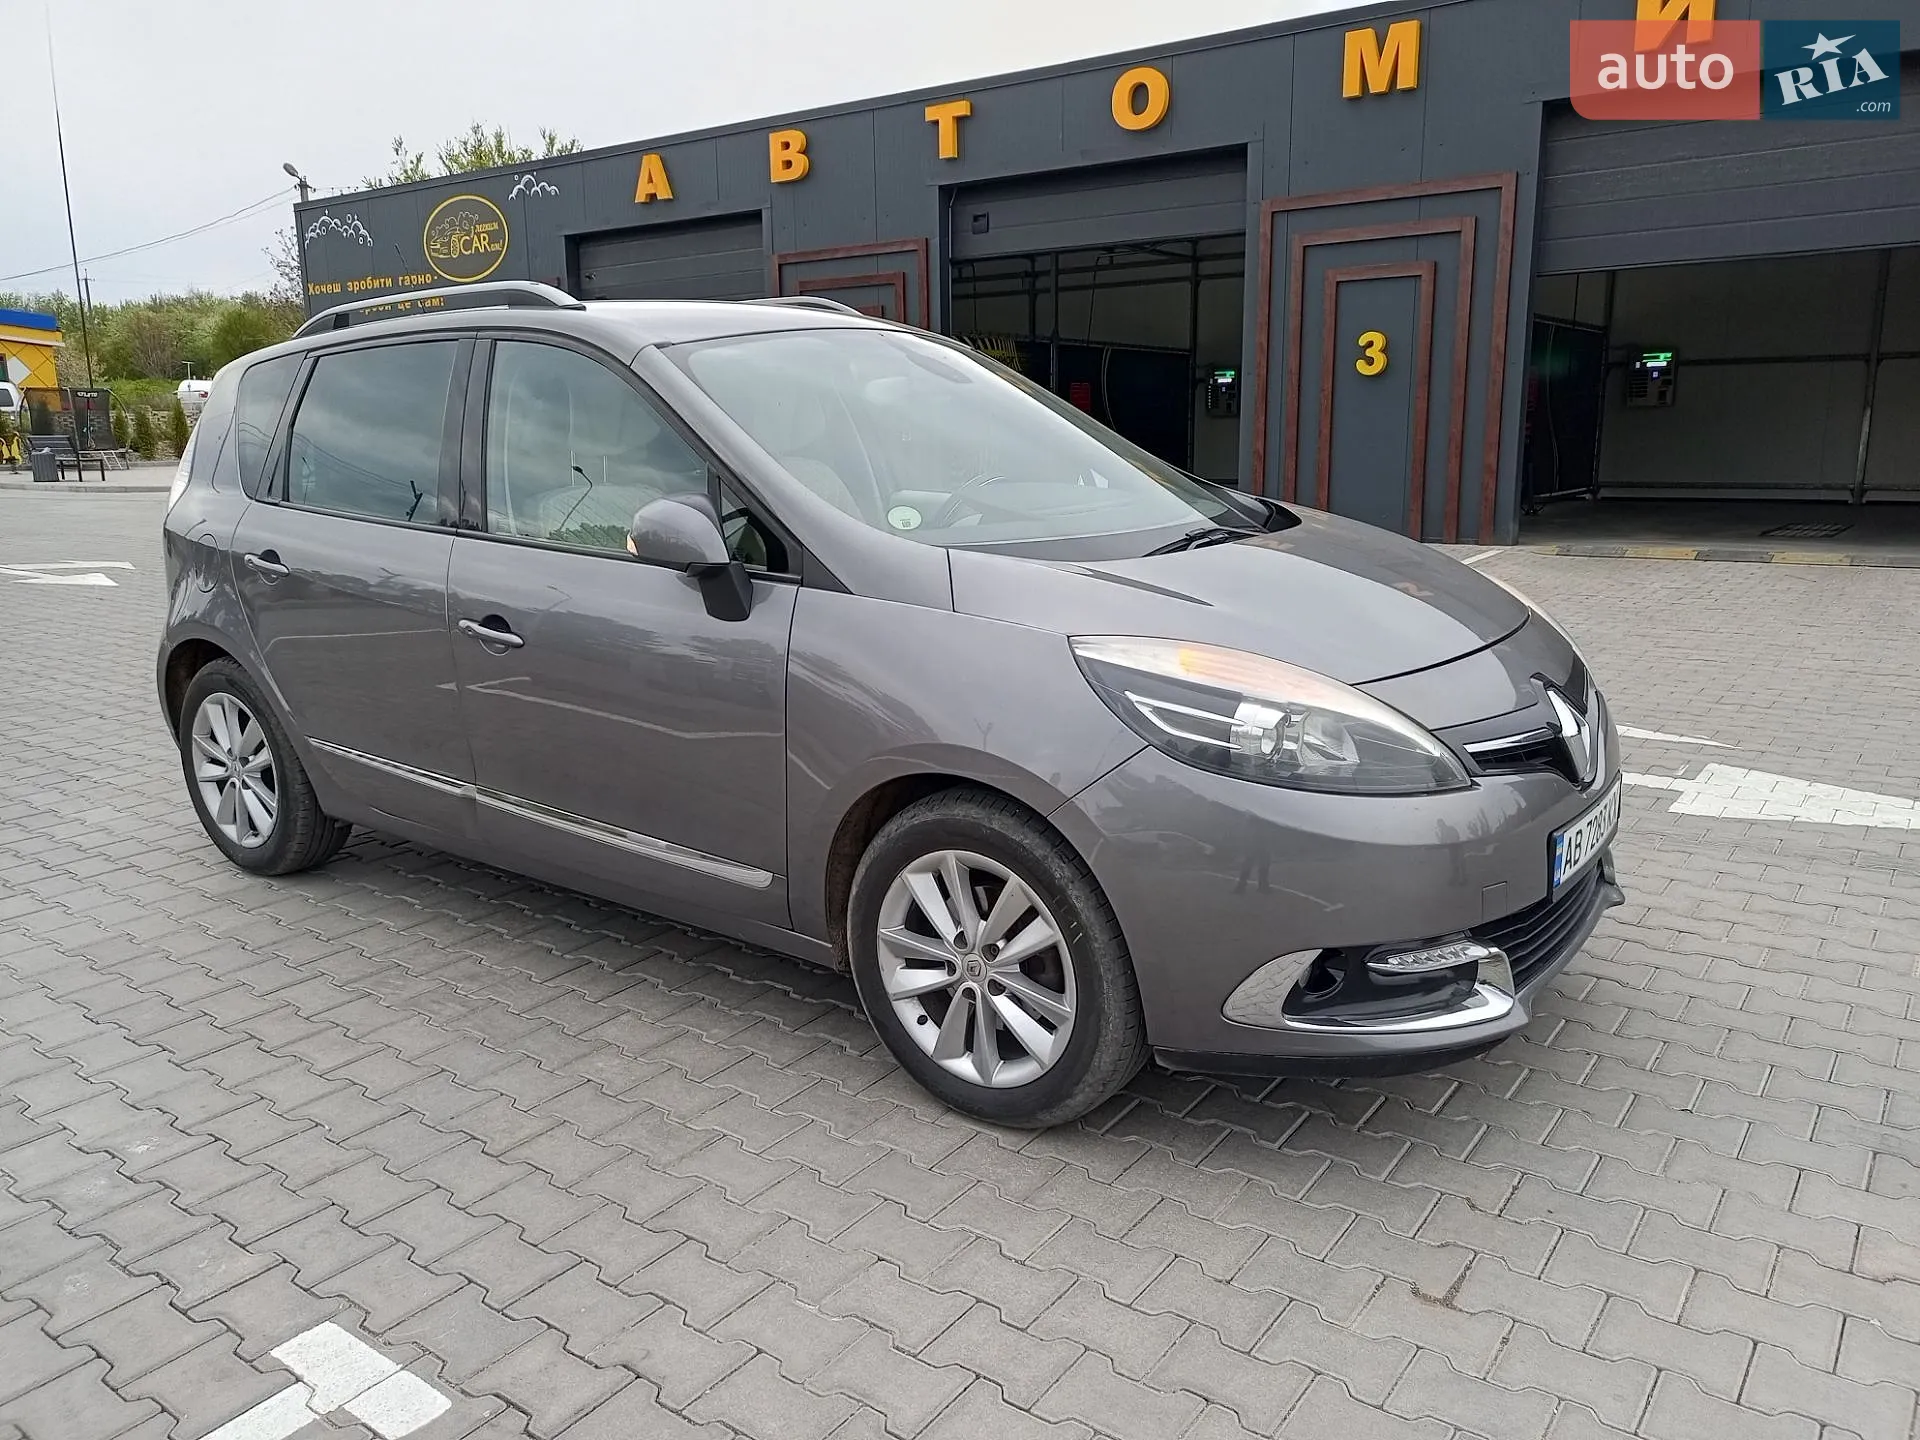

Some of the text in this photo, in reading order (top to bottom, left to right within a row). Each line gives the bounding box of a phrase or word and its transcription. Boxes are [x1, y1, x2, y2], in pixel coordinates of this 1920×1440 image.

[307, 282, 342, 296] Хочеш
[346, 275, 393, 294] зробити
[1355, 331, 1388, 376] 3
